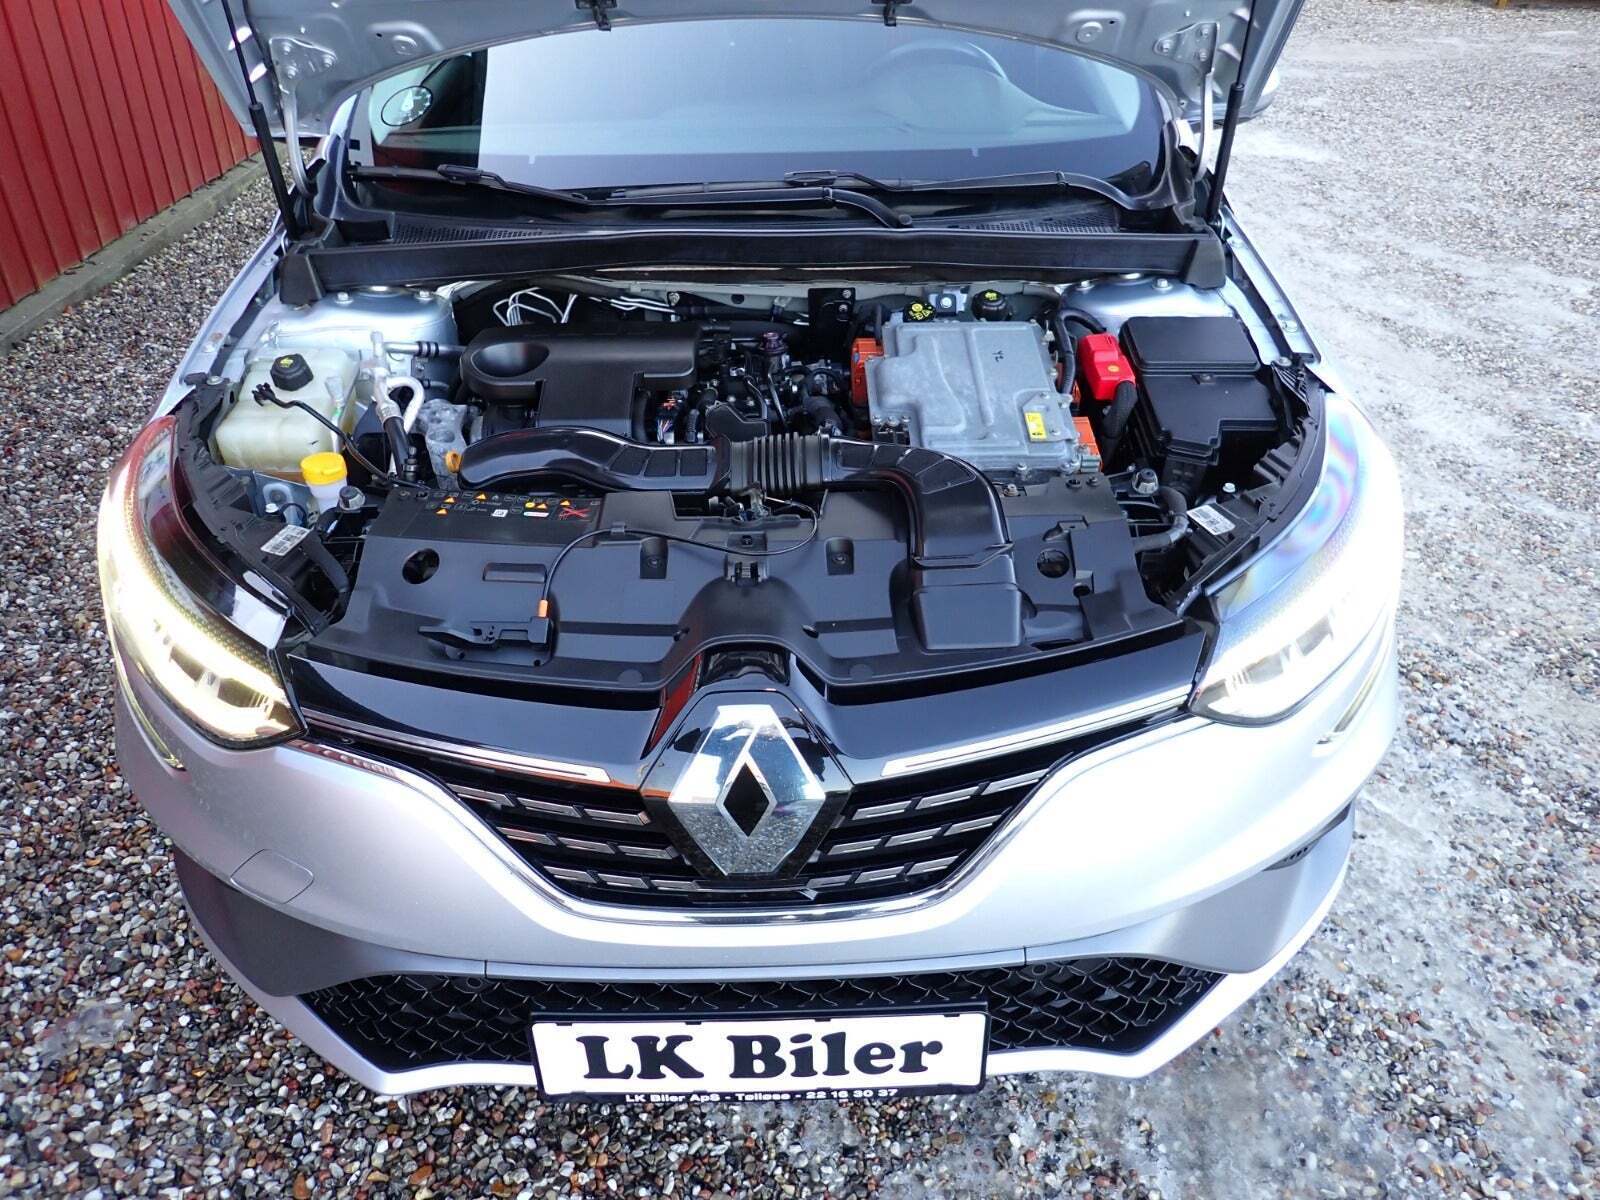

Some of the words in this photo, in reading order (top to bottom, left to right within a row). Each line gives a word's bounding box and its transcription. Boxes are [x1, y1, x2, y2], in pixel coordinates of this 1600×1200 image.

[575, 1034, 705, 1080] LK
[726, 1031, 943, 1079] Biler
[625, 1094, 646, 1103] LK
[649, 1093, 686, 1103] Biler
[689, 1093, 721, 1103] ApS
[805, 1091, 827, 1099] 22
[853, 1089, 874, 1098] 30
[877, 1088, 899, 1097] 37
